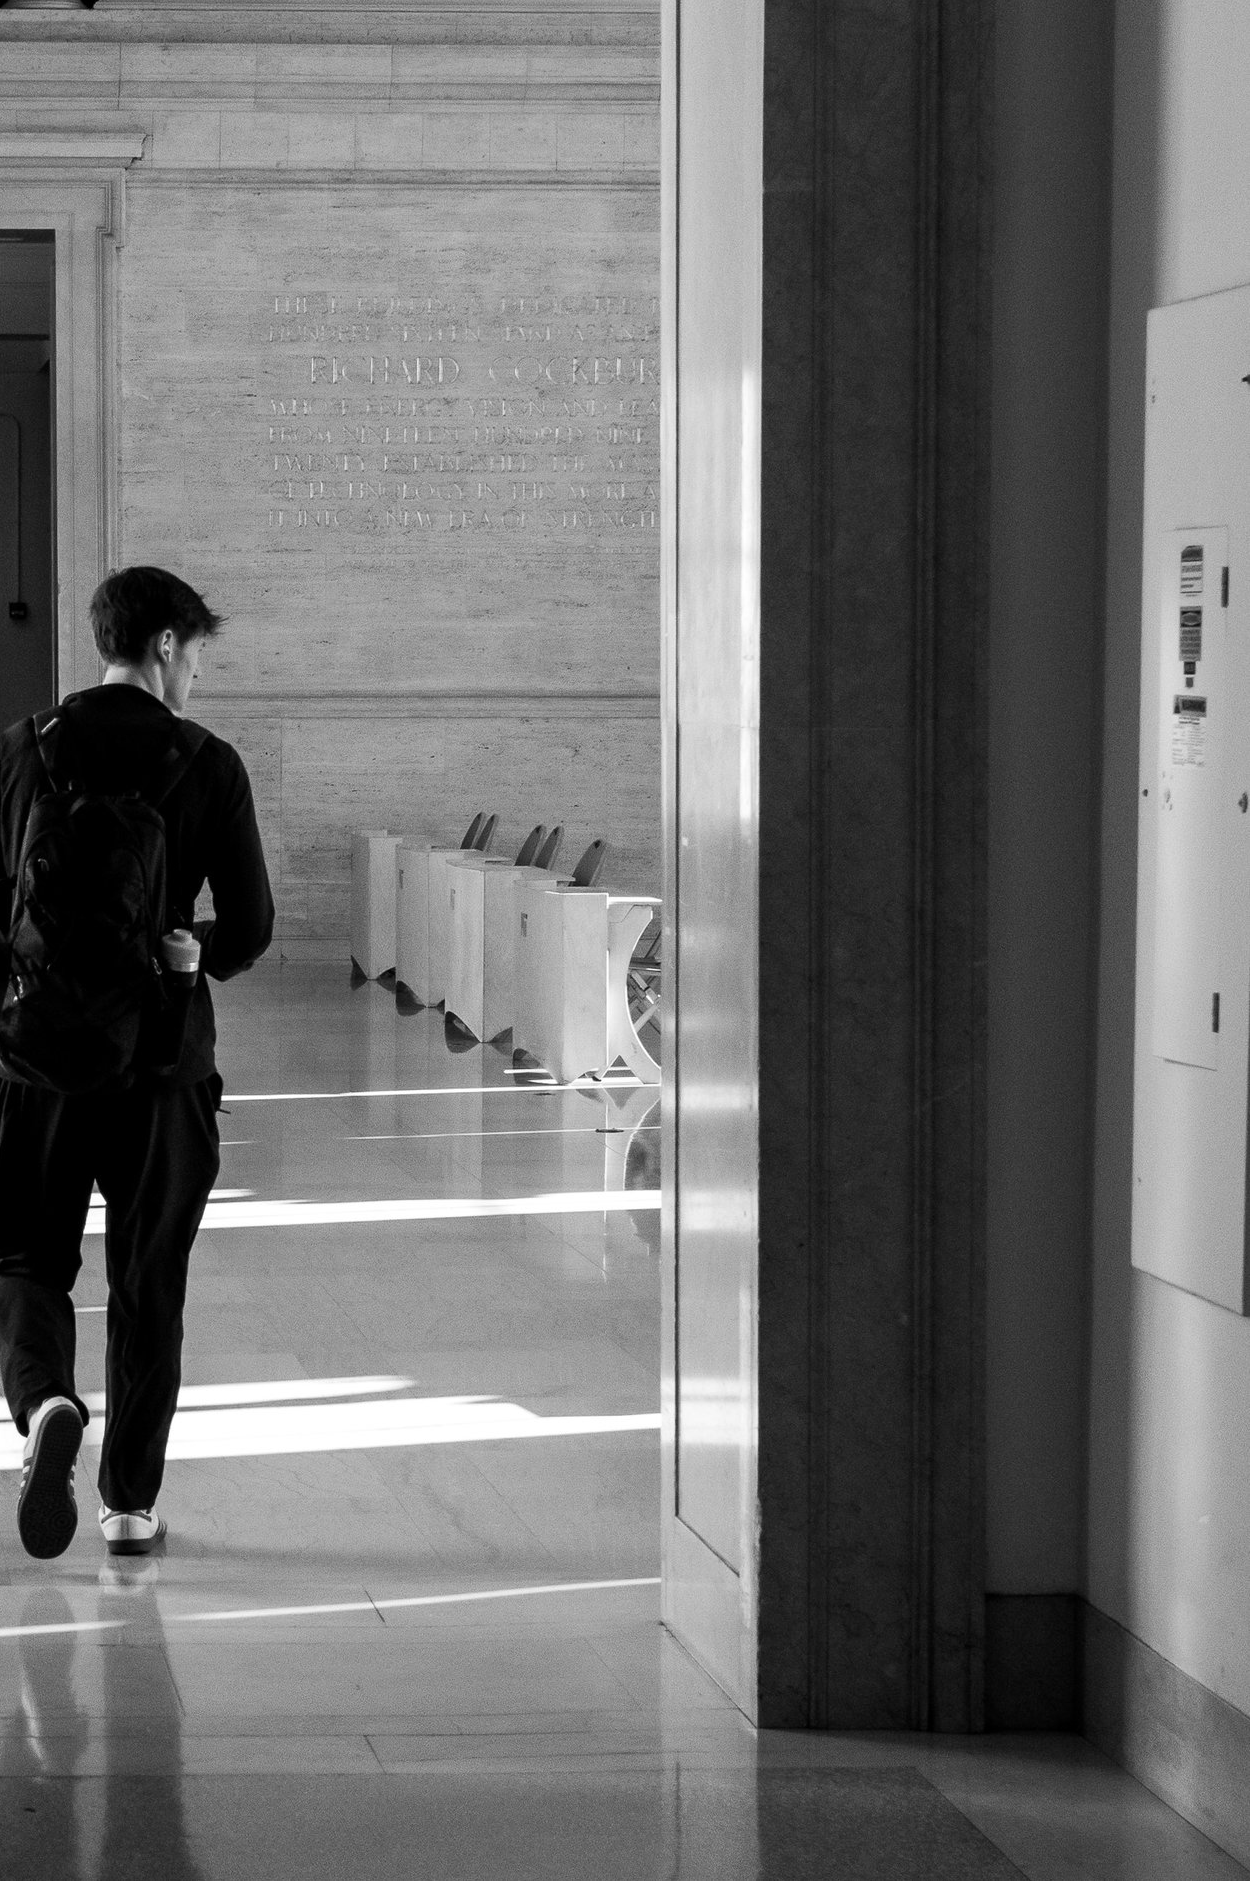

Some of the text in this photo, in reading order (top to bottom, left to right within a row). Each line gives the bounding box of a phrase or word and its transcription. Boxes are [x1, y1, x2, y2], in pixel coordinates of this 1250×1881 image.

[310, 356, 461, 385] RICHARD
[269, 398, 349, 417] WHOSE
[364, 398, 458, 417] ENERGY
[466, 398, 545, 417] VISION
[561, 398, 609, 417] AND
[268, 426, 647, 444] FROM NINETEEN HUNDRED NINE
[271, 454, 367, 472] TWENTY
[382, 454, 539, 472] ESTABLISHED
[549, 454, 591, 472] THE
[305, 481, 465, 500] TECHNOLOGY
[477, 481, 499, 500] IN
[509, 481, 557, 500] THIS
[568, 481, 631, 500] MORE
[298, 509, 353, 528] INTO
[386, 509, 434, 528] NEW
[448, 509, 492, 528] ERA
[501, 509, 528, 528] OF
